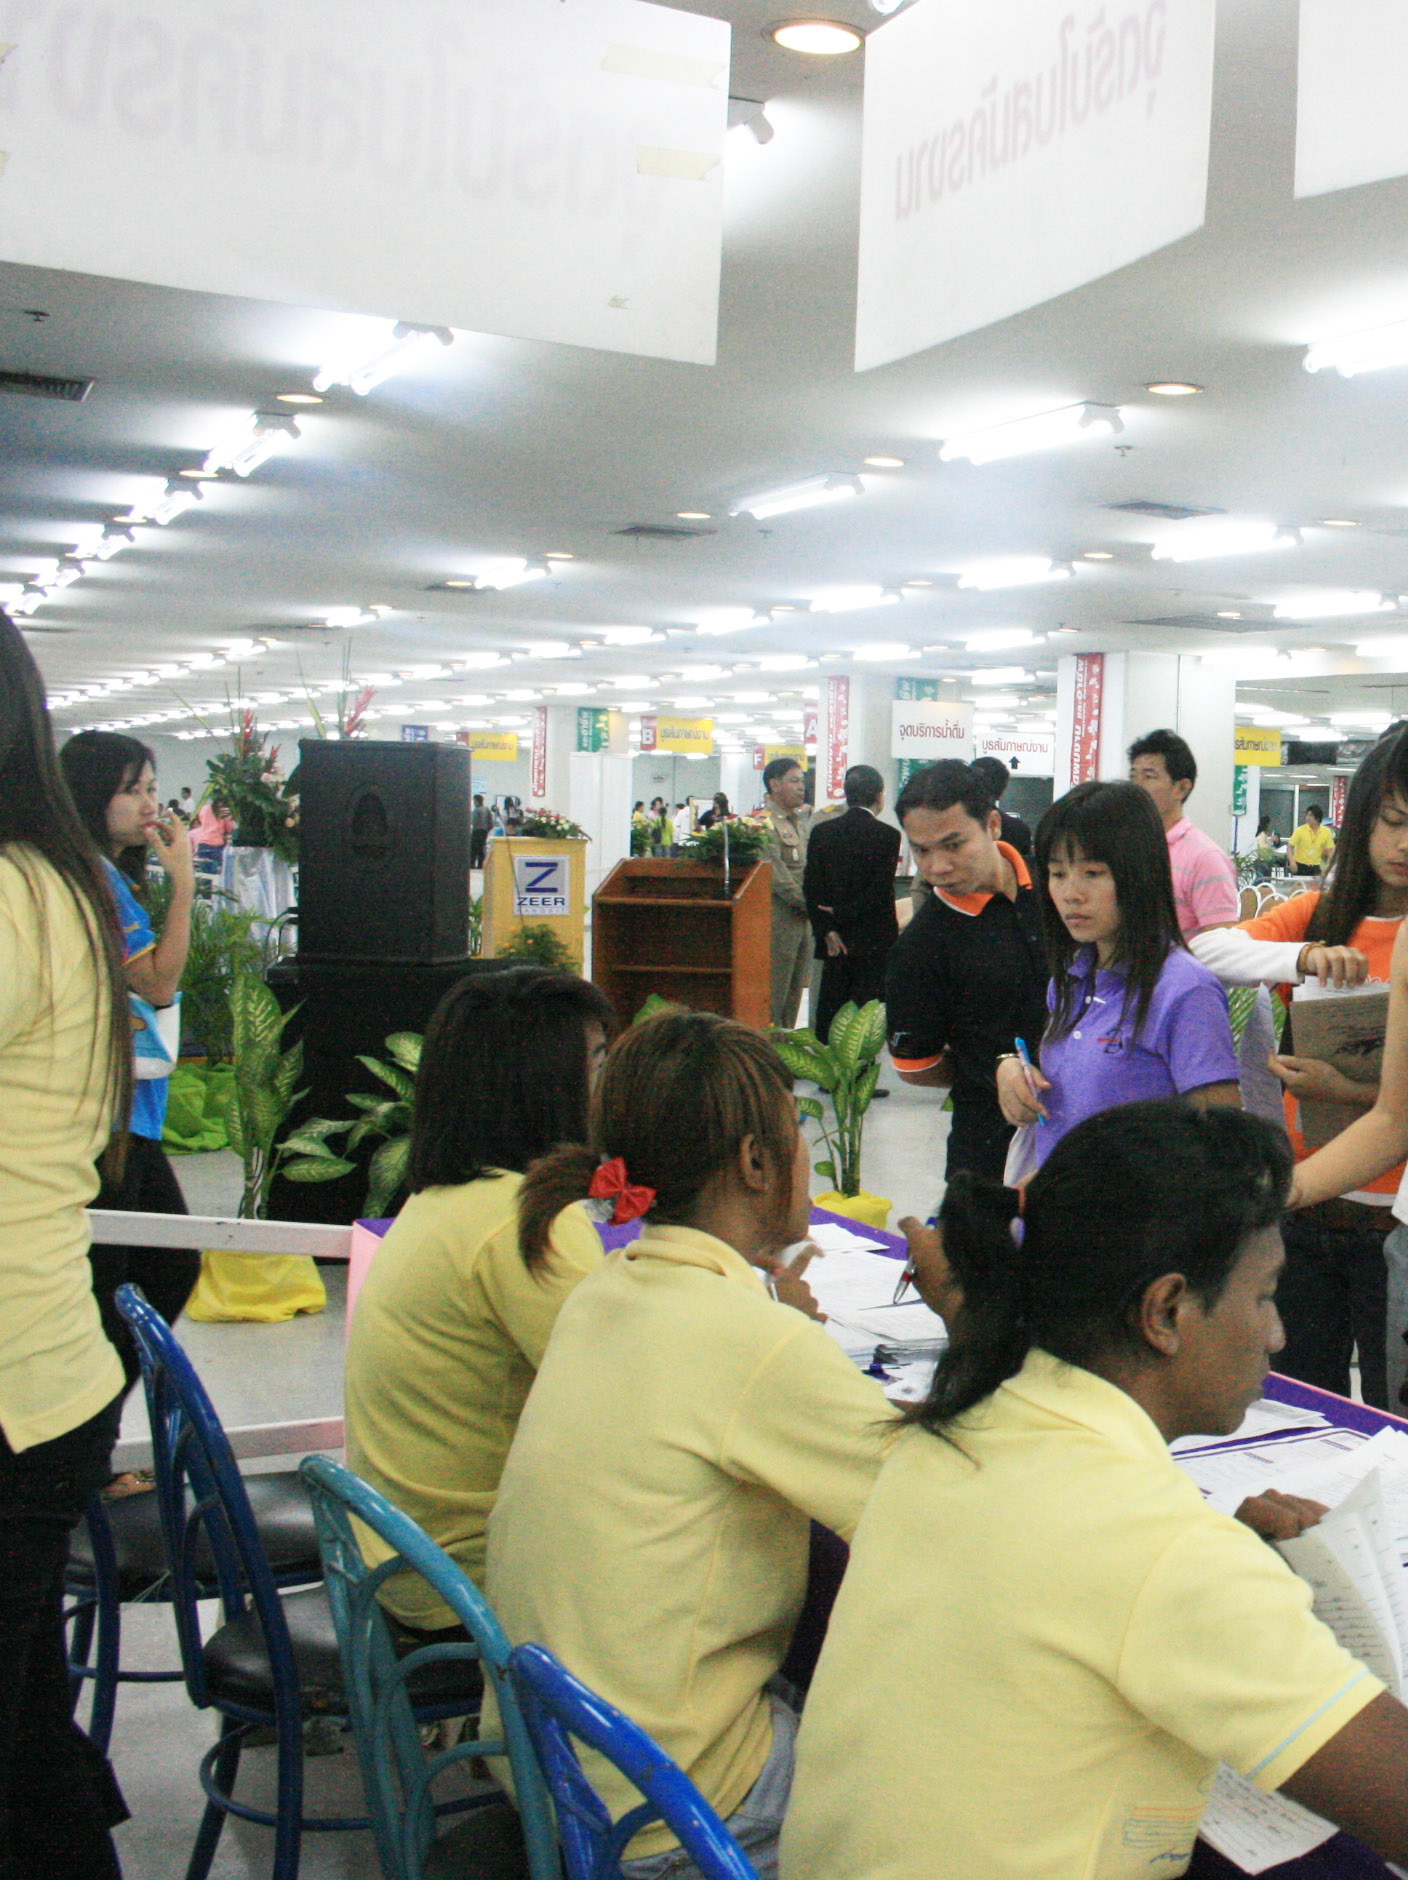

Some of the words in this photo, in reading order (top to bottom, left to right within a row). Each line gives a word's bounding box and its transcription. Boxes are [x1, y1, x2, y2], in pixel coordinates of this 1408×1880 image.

[642, 728, 655, 745] B
[899, 719, 965, 741] จุดบริการน้ำดื่ม
[525, 862, 558, 893] Z
[517, 897, 566, 906] ZEER
